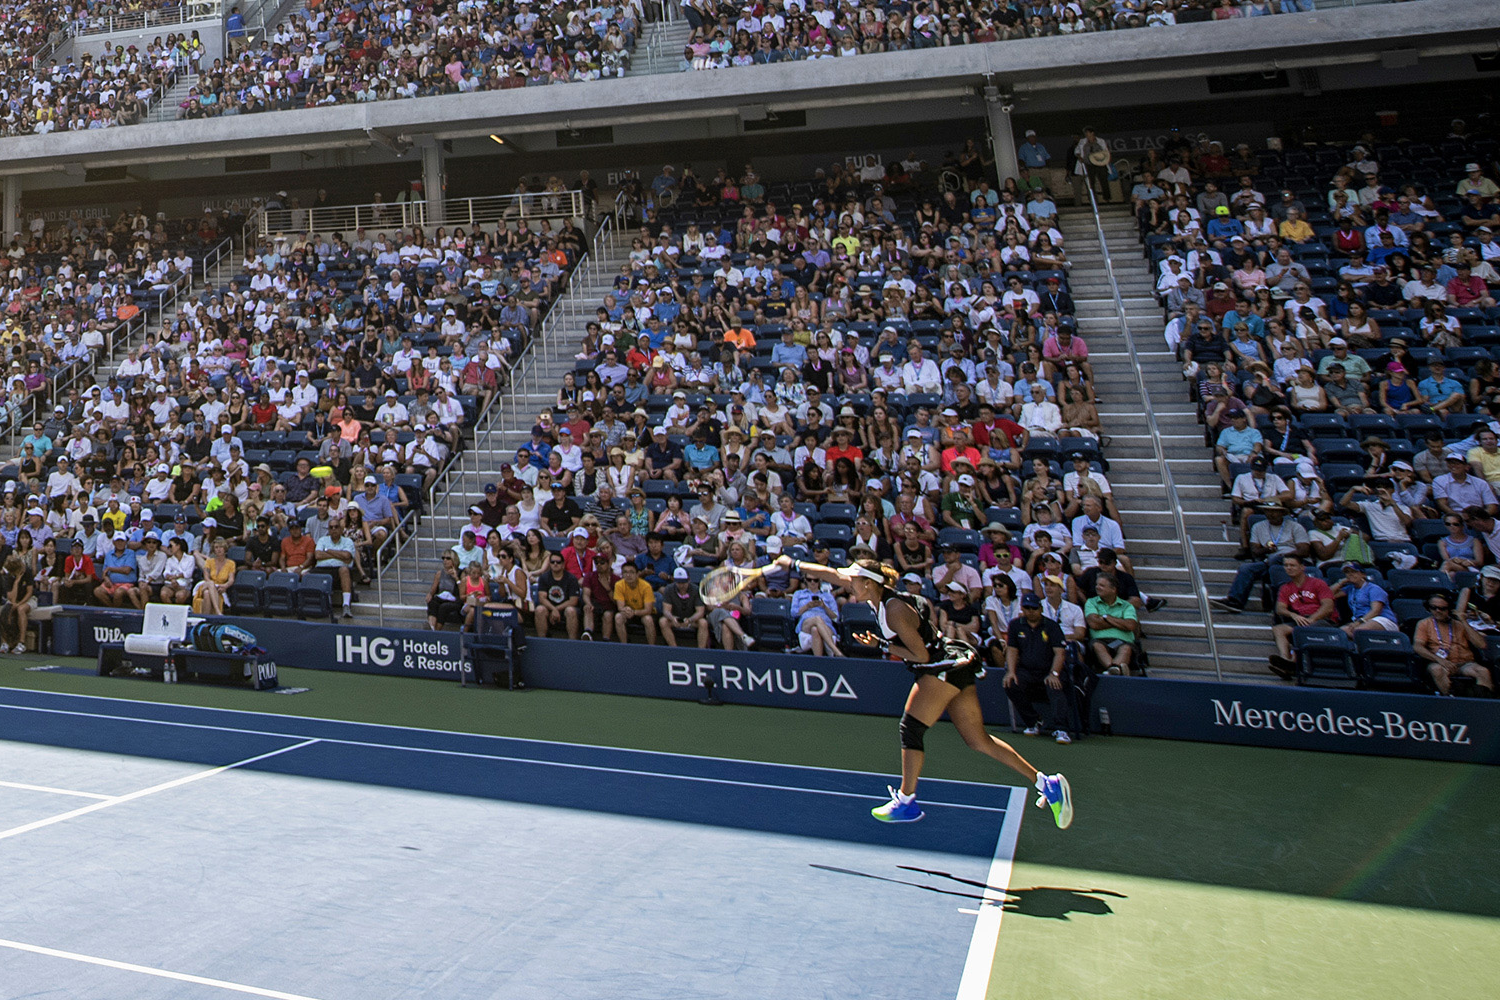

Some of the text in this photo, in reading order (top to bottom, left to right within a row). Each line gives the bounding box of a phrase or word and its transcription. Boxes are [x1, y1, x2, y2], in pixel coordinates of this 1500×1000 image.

[1131, 133, 1197, 151] TACS
[845, 154, 882, 169] FUU
[225, 196, 271, 210] CUNRY
[27, 207, 111, 223] GND SLM GRILL
[94, 626, 126, 643] Wils
[403, 639, 449, 656] Hotels
[257, 661, 277, 681] POLO
[403, 655, 472, 673] & Resorts
[667, 661, 858, 699] BERMUDA
[1211, 699, 1472, 745] Mercedes-Benz
